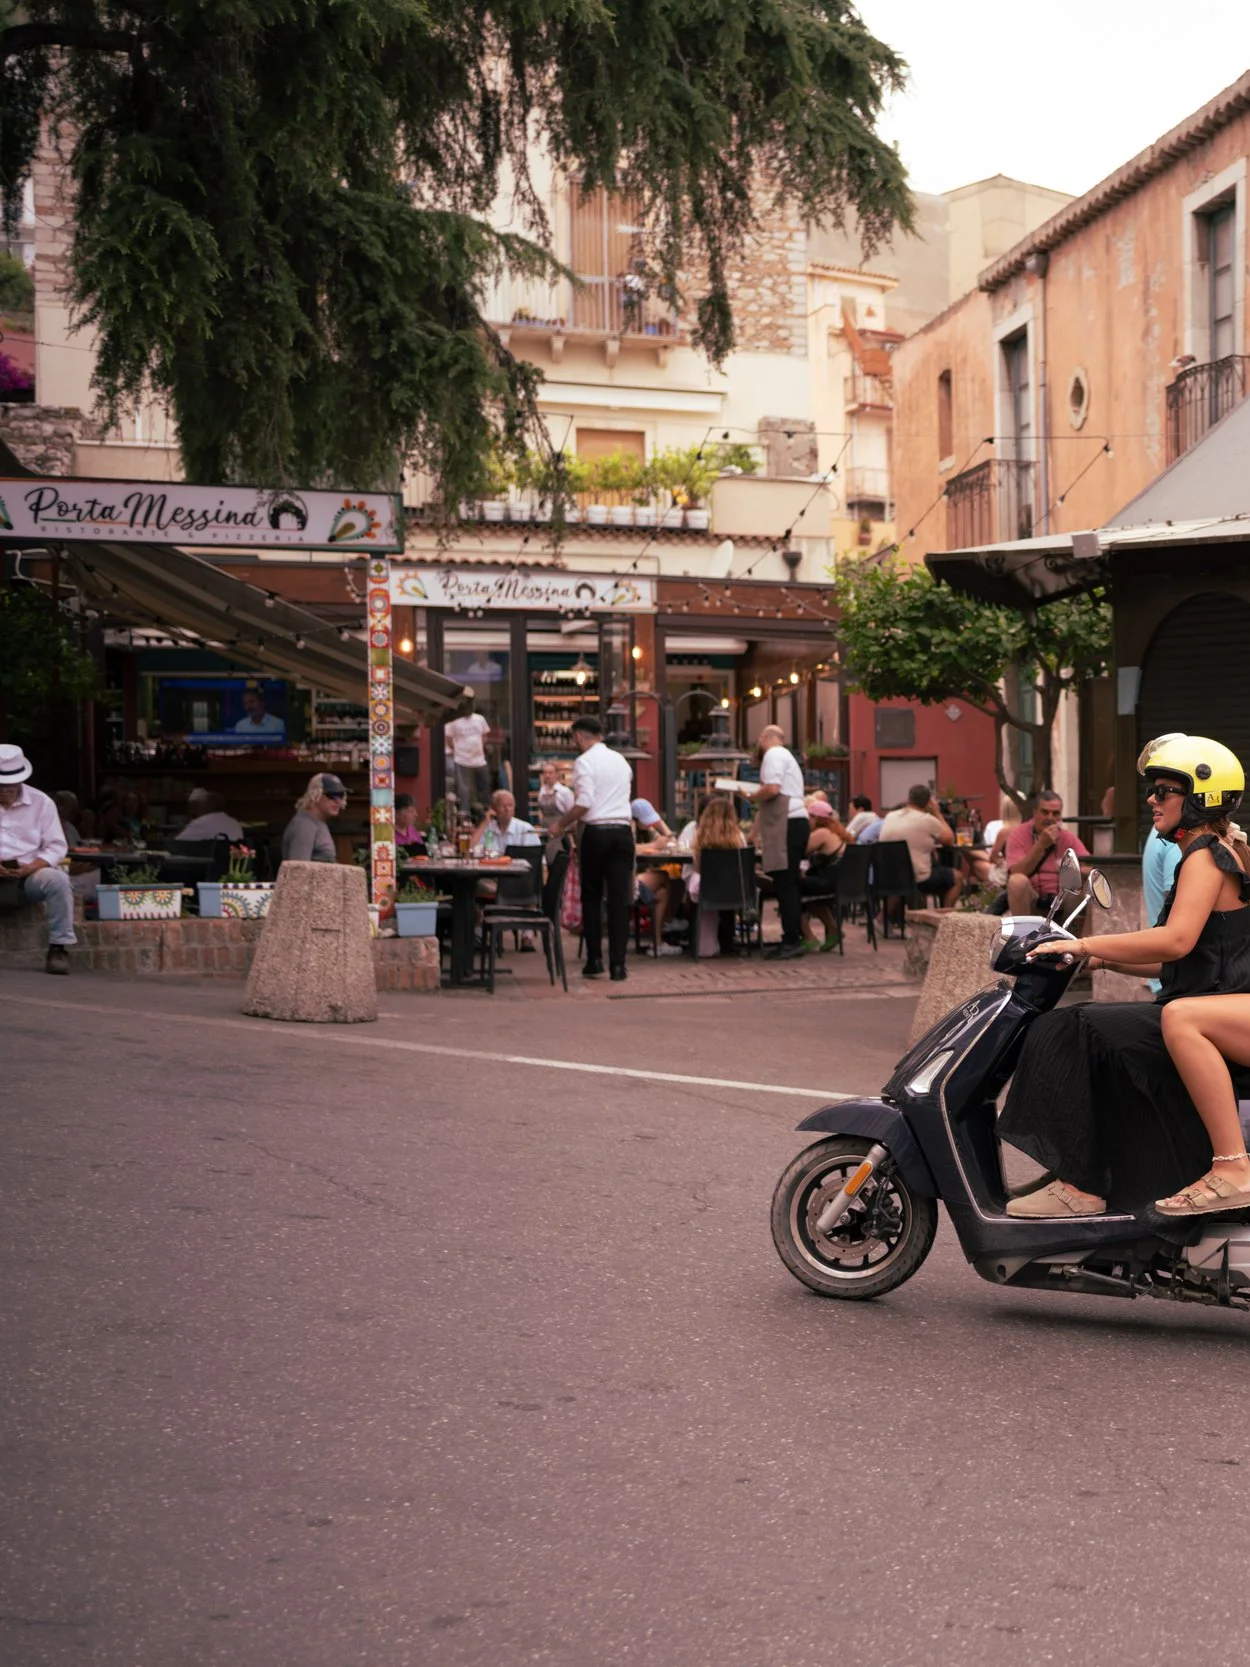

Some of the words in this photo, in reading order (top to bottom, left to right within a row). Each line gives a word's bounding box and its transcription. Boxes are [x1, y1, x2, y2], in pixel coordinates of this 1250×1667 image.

[24, 486, 124, 524] Porta
[122, 491, 264, 531] Messina
[41, 525, 168, 537] RISTORANTE
[212, 532, 304, 542] PIZZERIA
[438, 570, 491, 597] Porta
[493, 576, 571, 599] Messina
